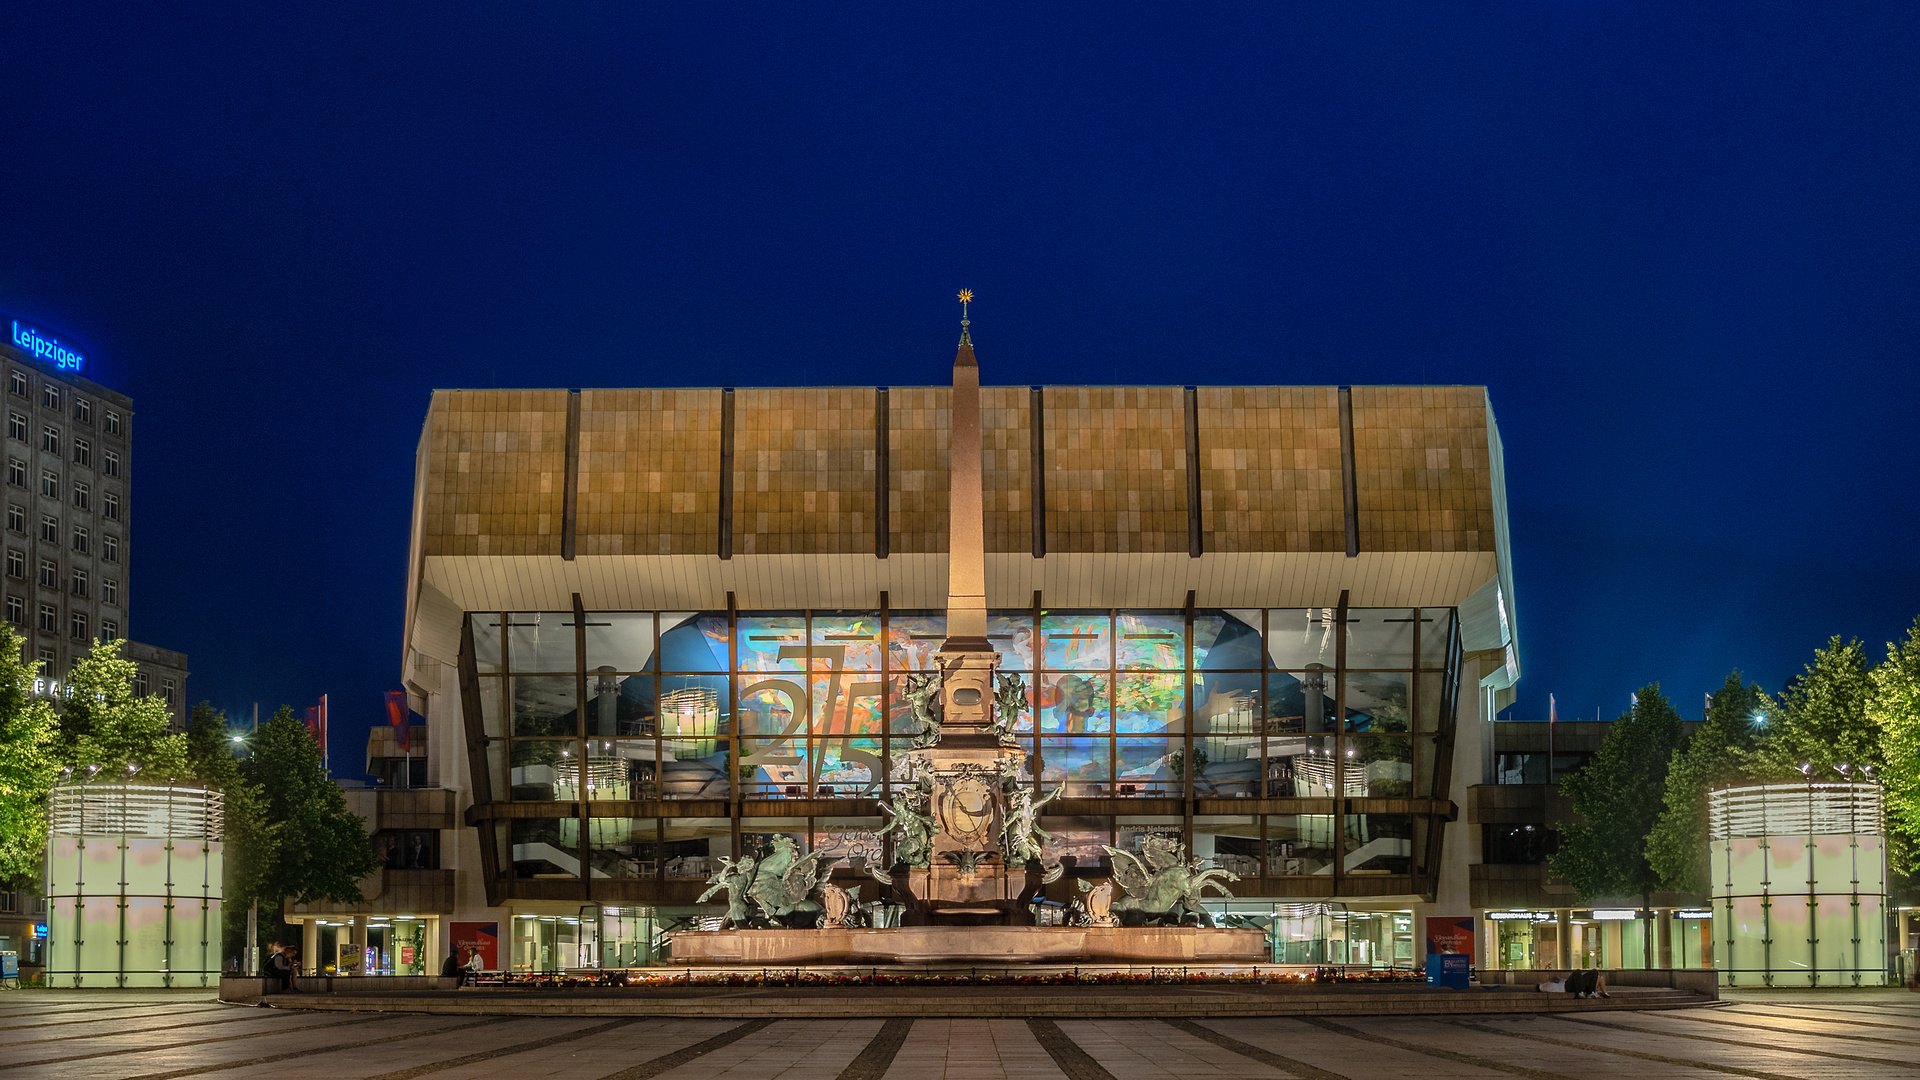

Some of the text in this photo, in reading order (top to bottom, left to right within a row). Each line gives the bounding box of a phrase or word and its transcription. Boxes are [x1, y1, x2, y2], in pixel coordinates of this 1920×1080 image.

[13, 321, 83, 370] Leipziger
[739, 645, 899, 799] 275
[1120, 825, 1182, 833] Andris Nelsons,
